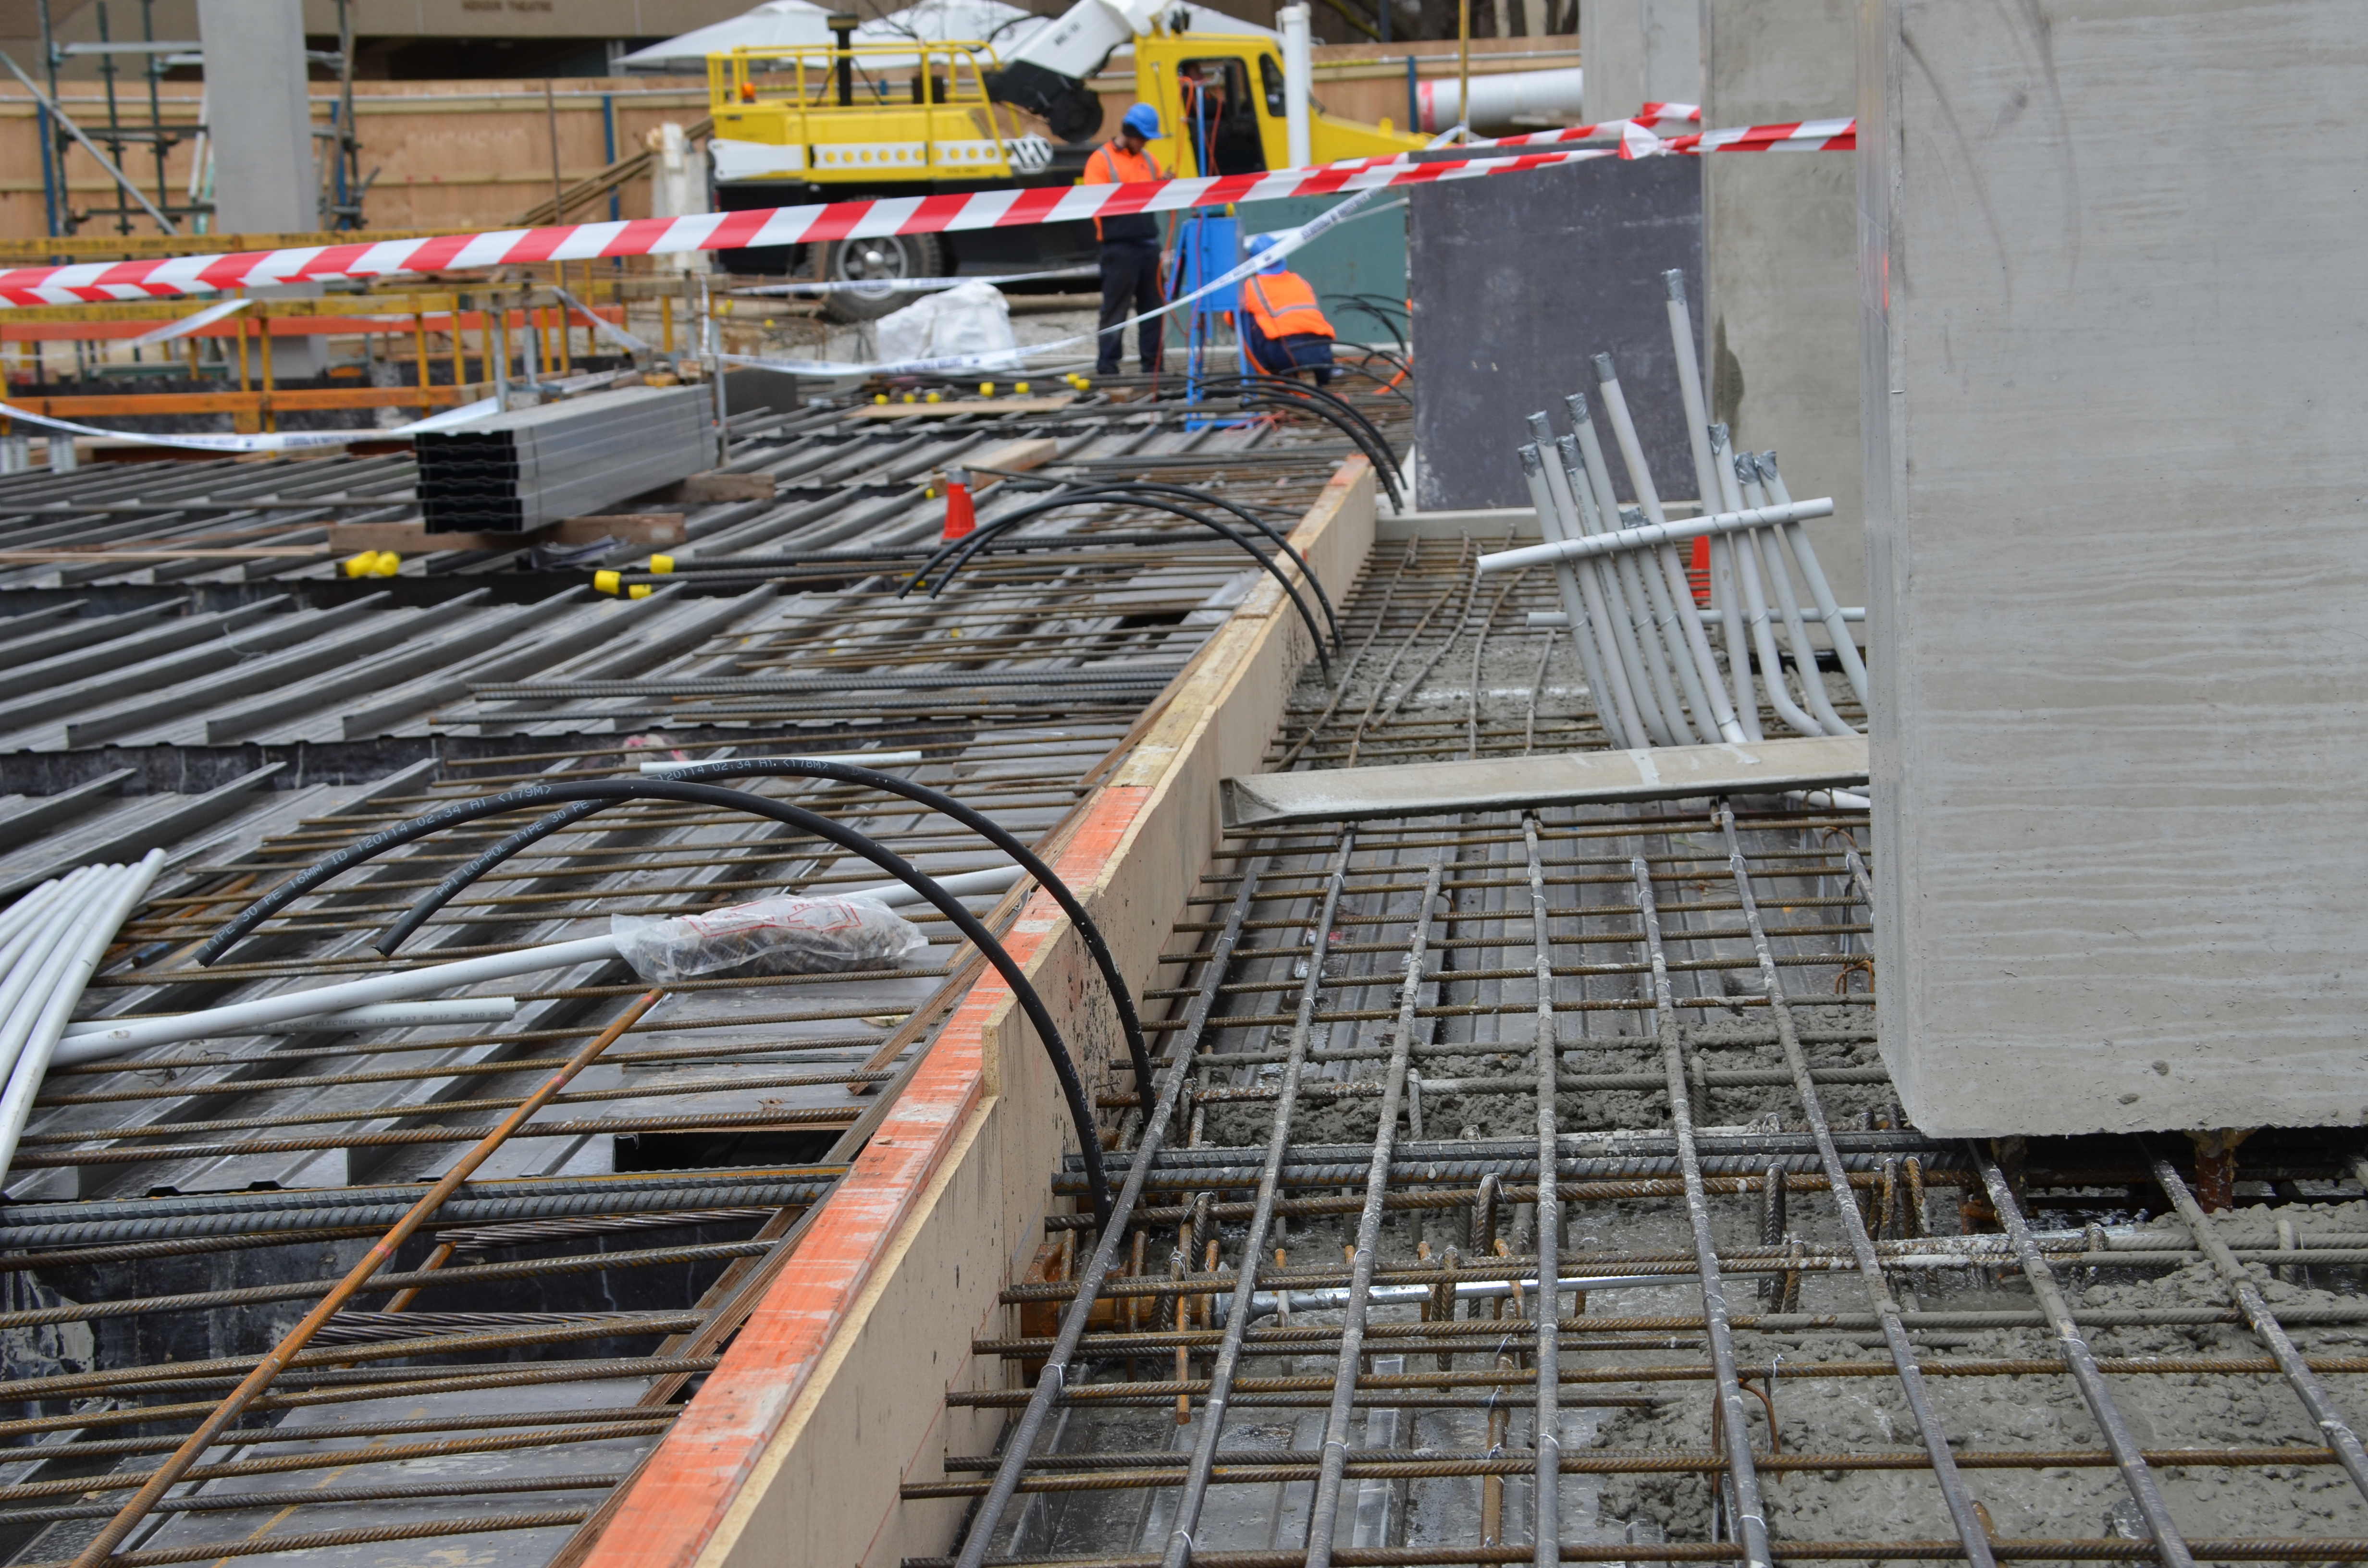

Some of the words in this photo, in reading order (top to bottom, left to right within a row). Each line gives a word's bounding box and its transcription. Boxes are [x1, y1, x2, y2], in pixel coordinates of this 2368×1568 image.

[658, 766, 705, 781] 120114
[712, 760, 752, 772] 02:34
[202, 923, 236, 951] TYPE
[241, 906, 258, 922] 30
[264, 889, 283, 906] PE
[288, 863, 323, 889] 16MM
[331, 850, 348, 865] ID
[356, 823, 408, 852] 120114
[417, 805, 462, 827] 02:34
[469, 798, 486, 810] A1
[497, 785, 552, 802] <179M>
[436, 876, 459, 897] PPI
[462, 844, 509, 877] LO-POL
[512, 821, 545, 842] TYPE
[551, 810, 566, 823] 30
[572, 800, 590, 813] PE
[316, 1018, 369, 1027] ELECTRICAL
